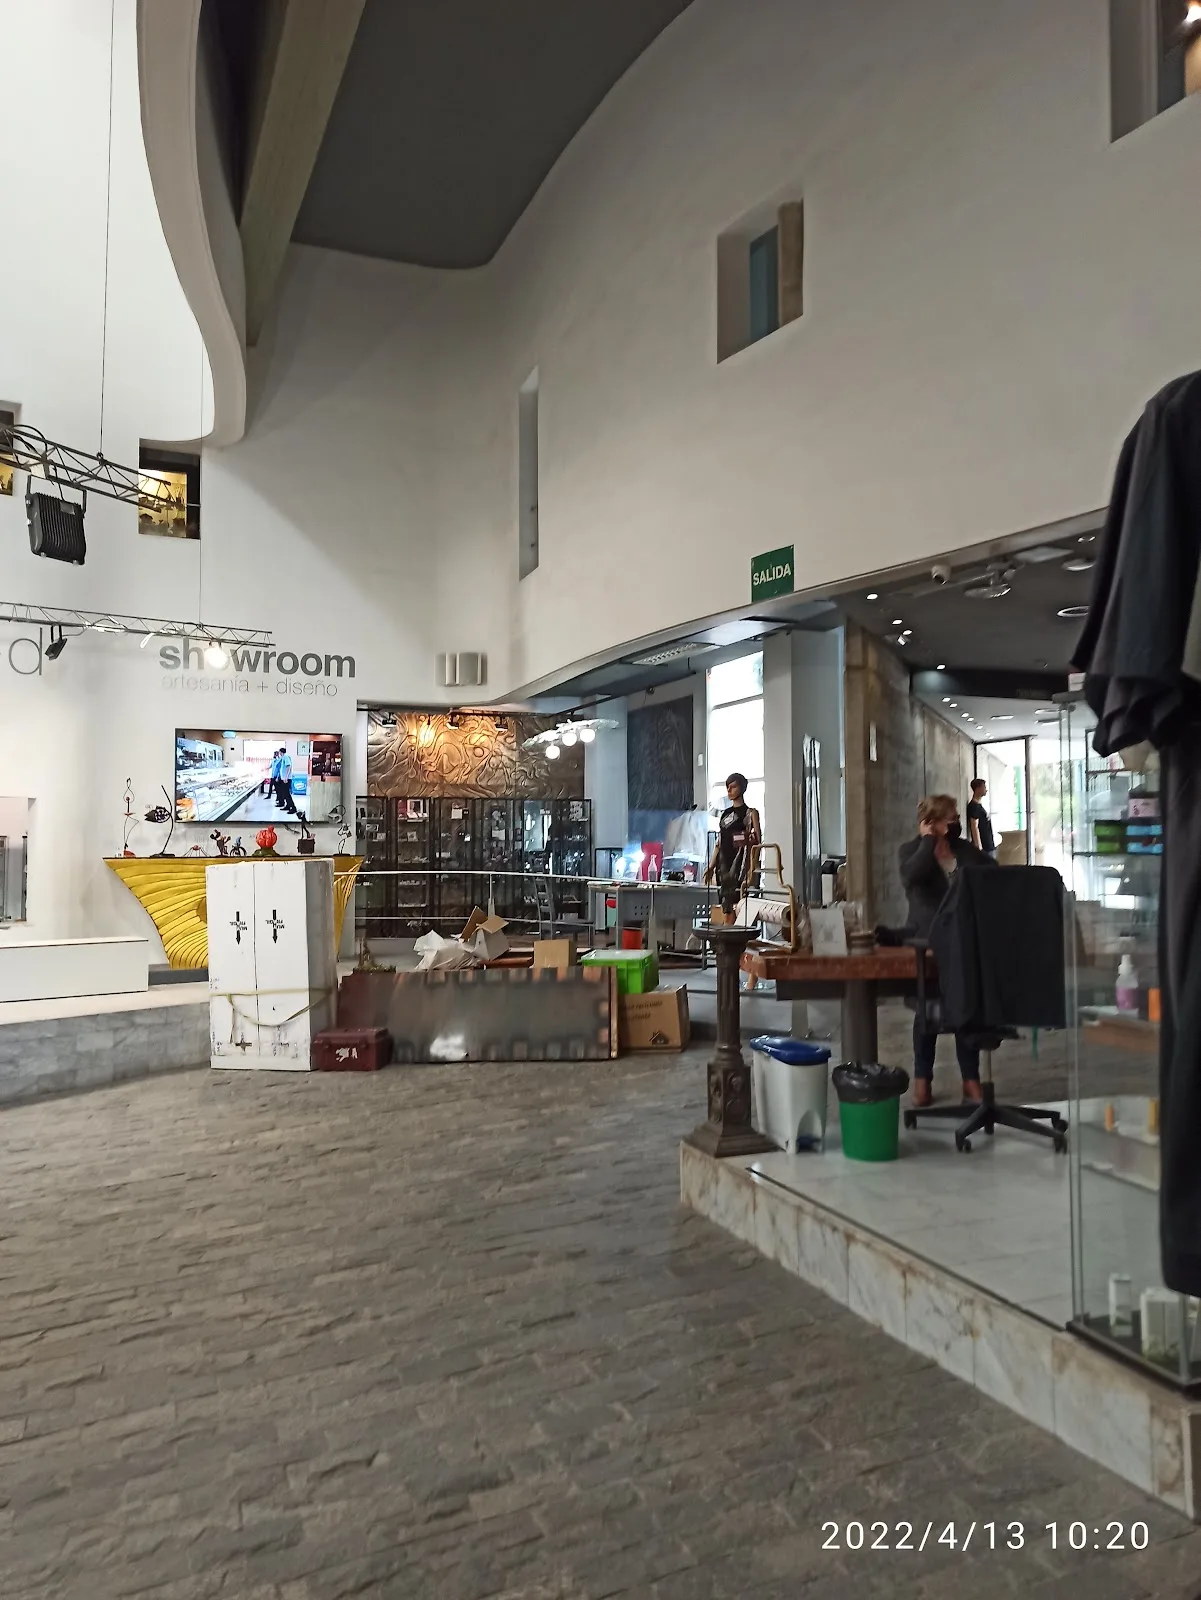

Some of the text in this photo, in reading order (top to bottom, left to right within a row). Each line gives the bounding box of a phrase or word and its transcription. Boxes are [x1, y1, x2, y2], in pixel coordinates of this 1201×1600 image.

[753, 563, 791, 586] SALIDA
[159, 637, 356, 678] shwroom
[276, 677, 338, 697] diseño
